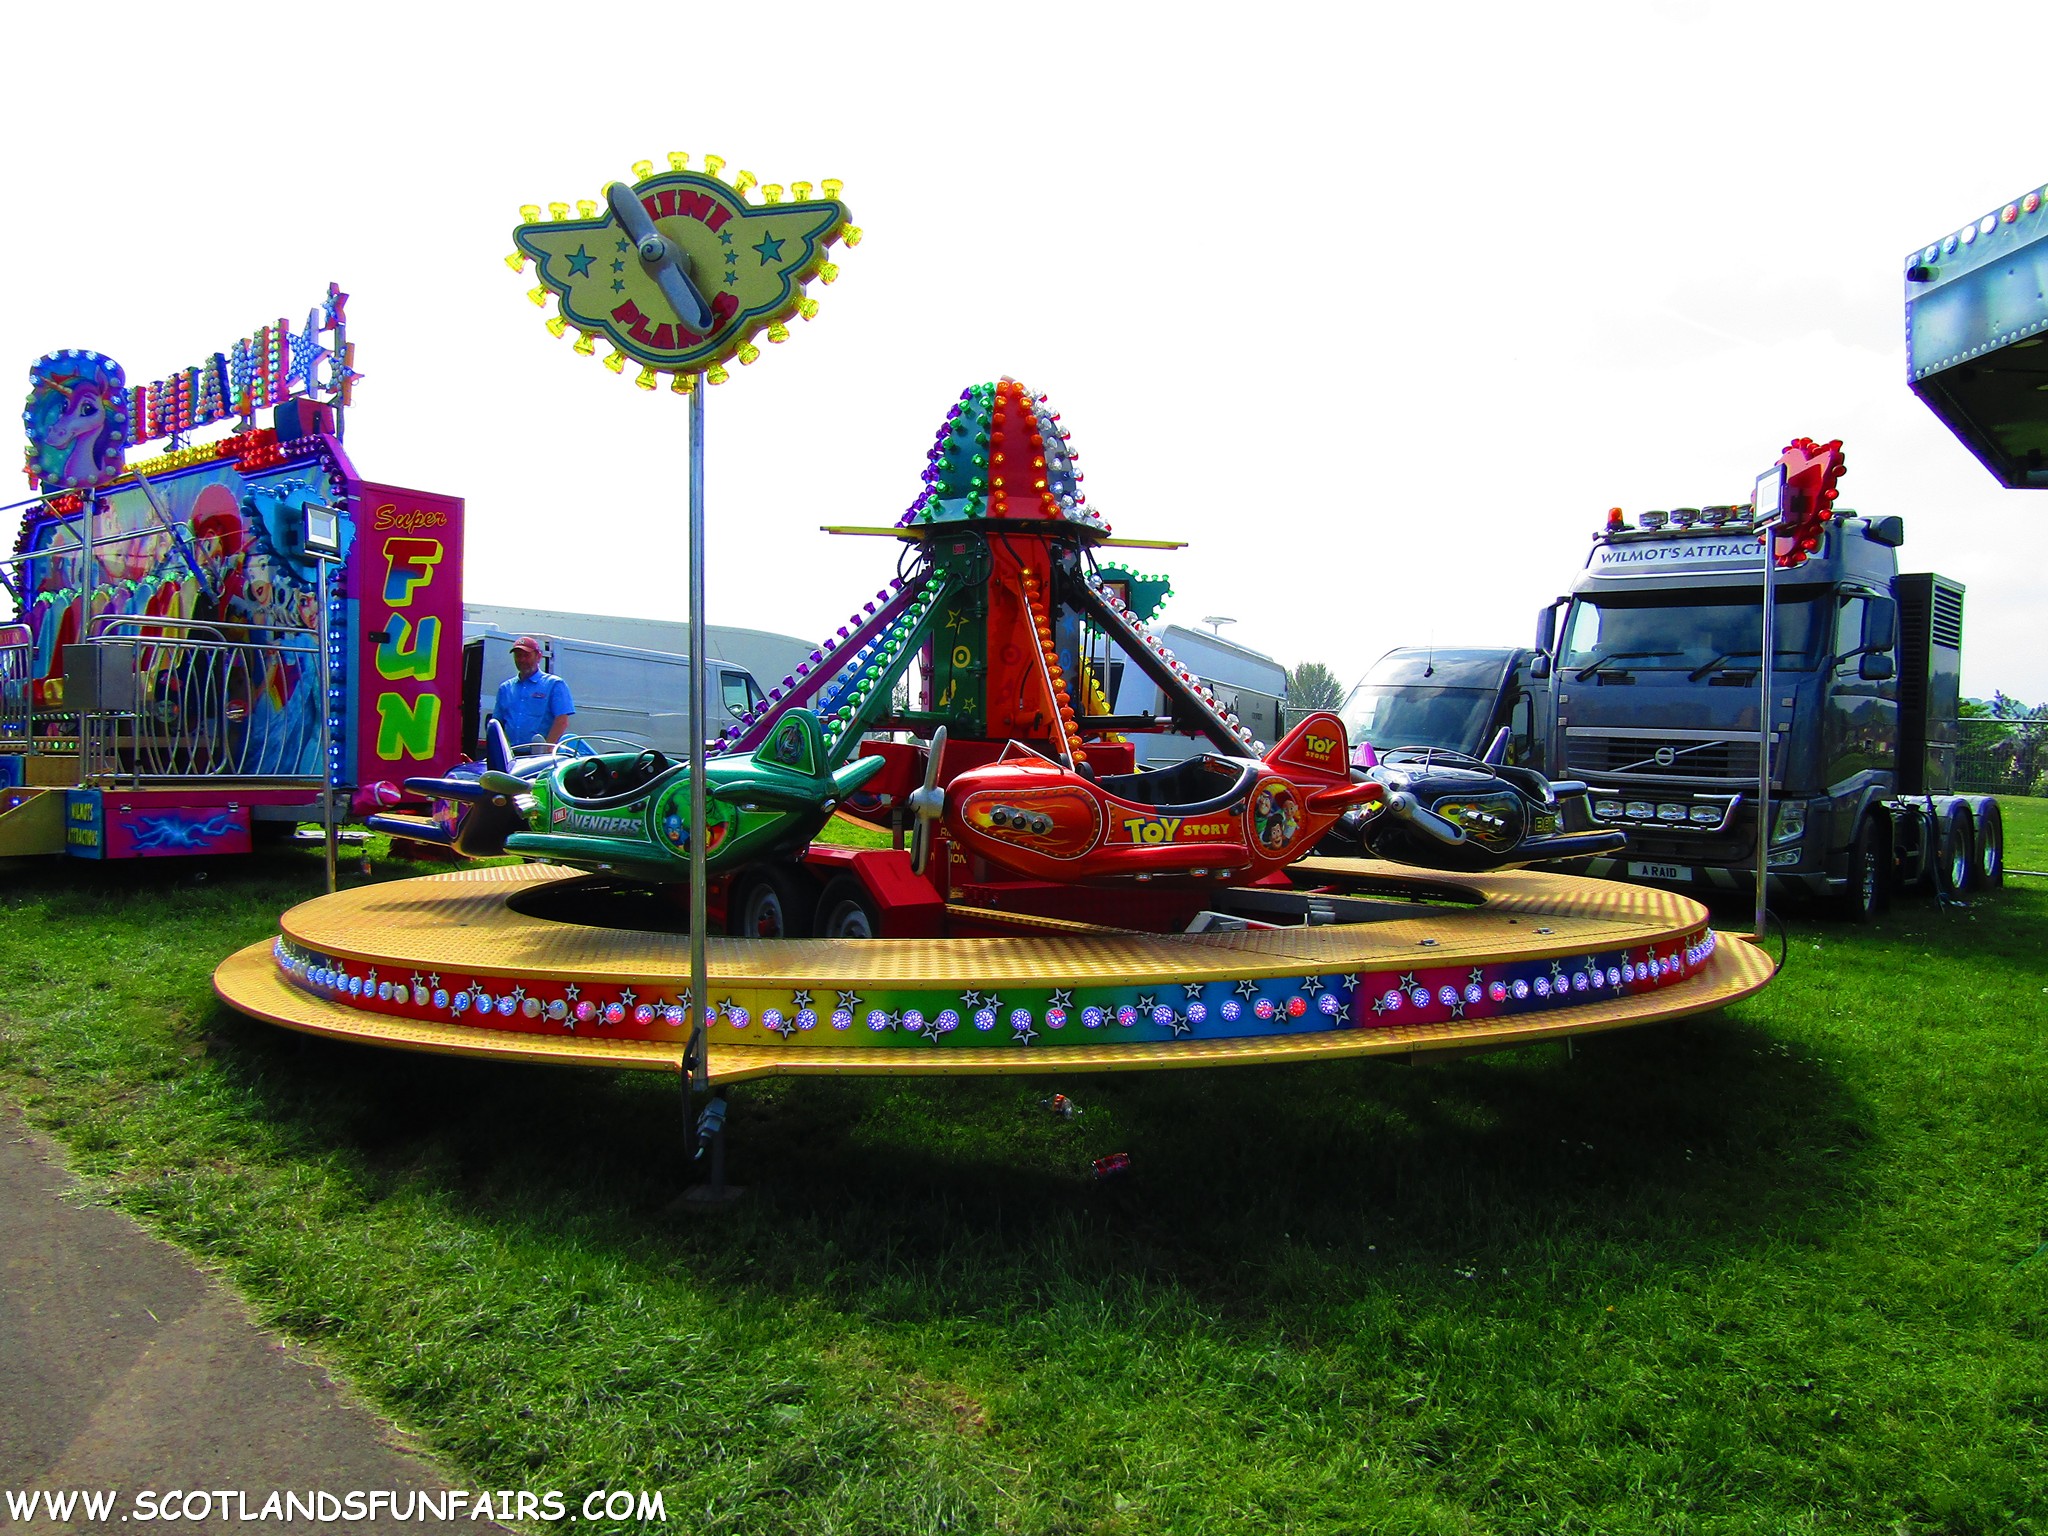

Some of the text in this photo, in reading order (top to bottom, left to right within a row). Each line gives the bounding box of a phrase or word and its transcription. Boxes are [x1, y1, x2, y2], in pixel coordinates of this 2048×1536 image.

[374, 503, 447, 534] Super
[1601, 546, 1681, 564] WILMOT'S
[375, 537, 444, 761] FUN
[1305, 734, 1337, 754] TOY
[1305, 751, 1330, 761] STORY
[554, 808, 642, 835] THE AVENGERS
[1123, 818, 1230, 844] TOY STORY
[1642, 865, 1677, 878] A RAID
